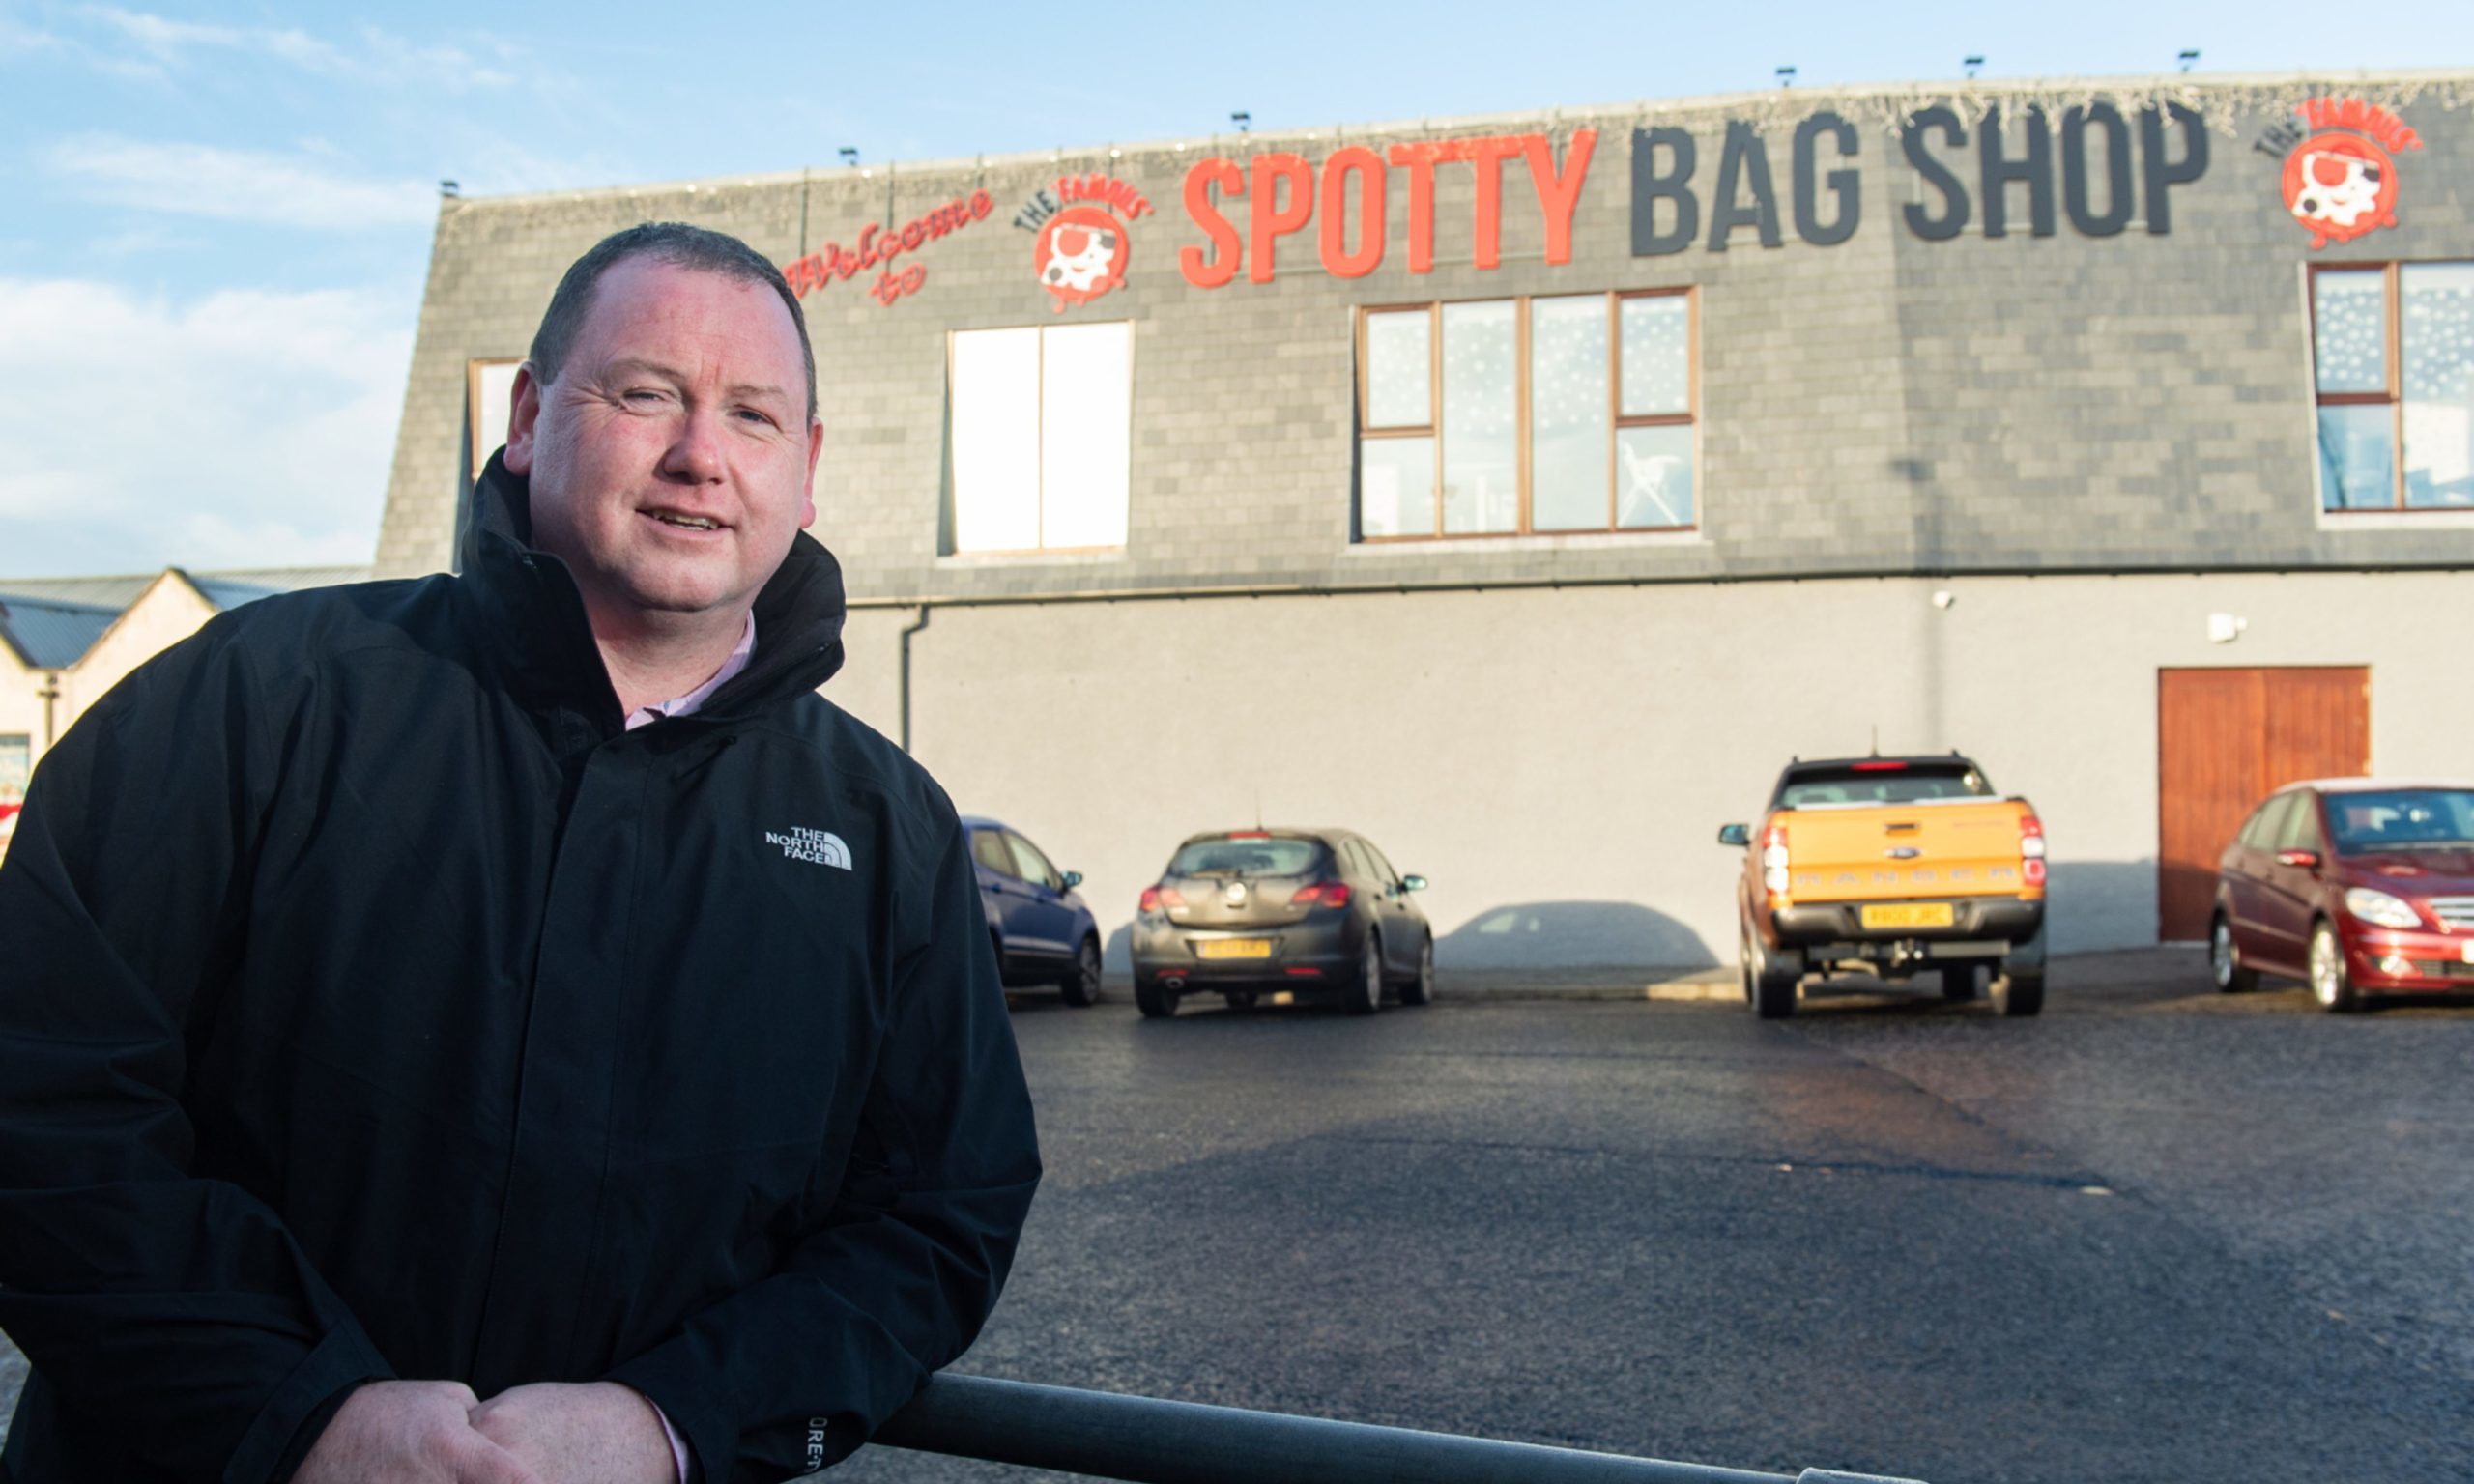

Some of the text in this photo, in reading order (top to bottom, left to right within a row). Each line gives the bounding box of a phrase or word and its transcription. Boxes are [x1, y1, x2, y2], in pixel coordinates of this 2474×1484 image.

[2253, 96, 2423, 159] THE FAMOUS
[1013, 172, 1153, 234] THE FAMOUS
[1179, 100, 2210, 289] SPOTTY BAG SHOP
[781, 187, 994, 299] Welcome
[868, 262, 927, 307] to
[765, 831, 824, 853] NORTH
[784, 845, 824, 865] FACE
[791, 826, 824, 842] THE
